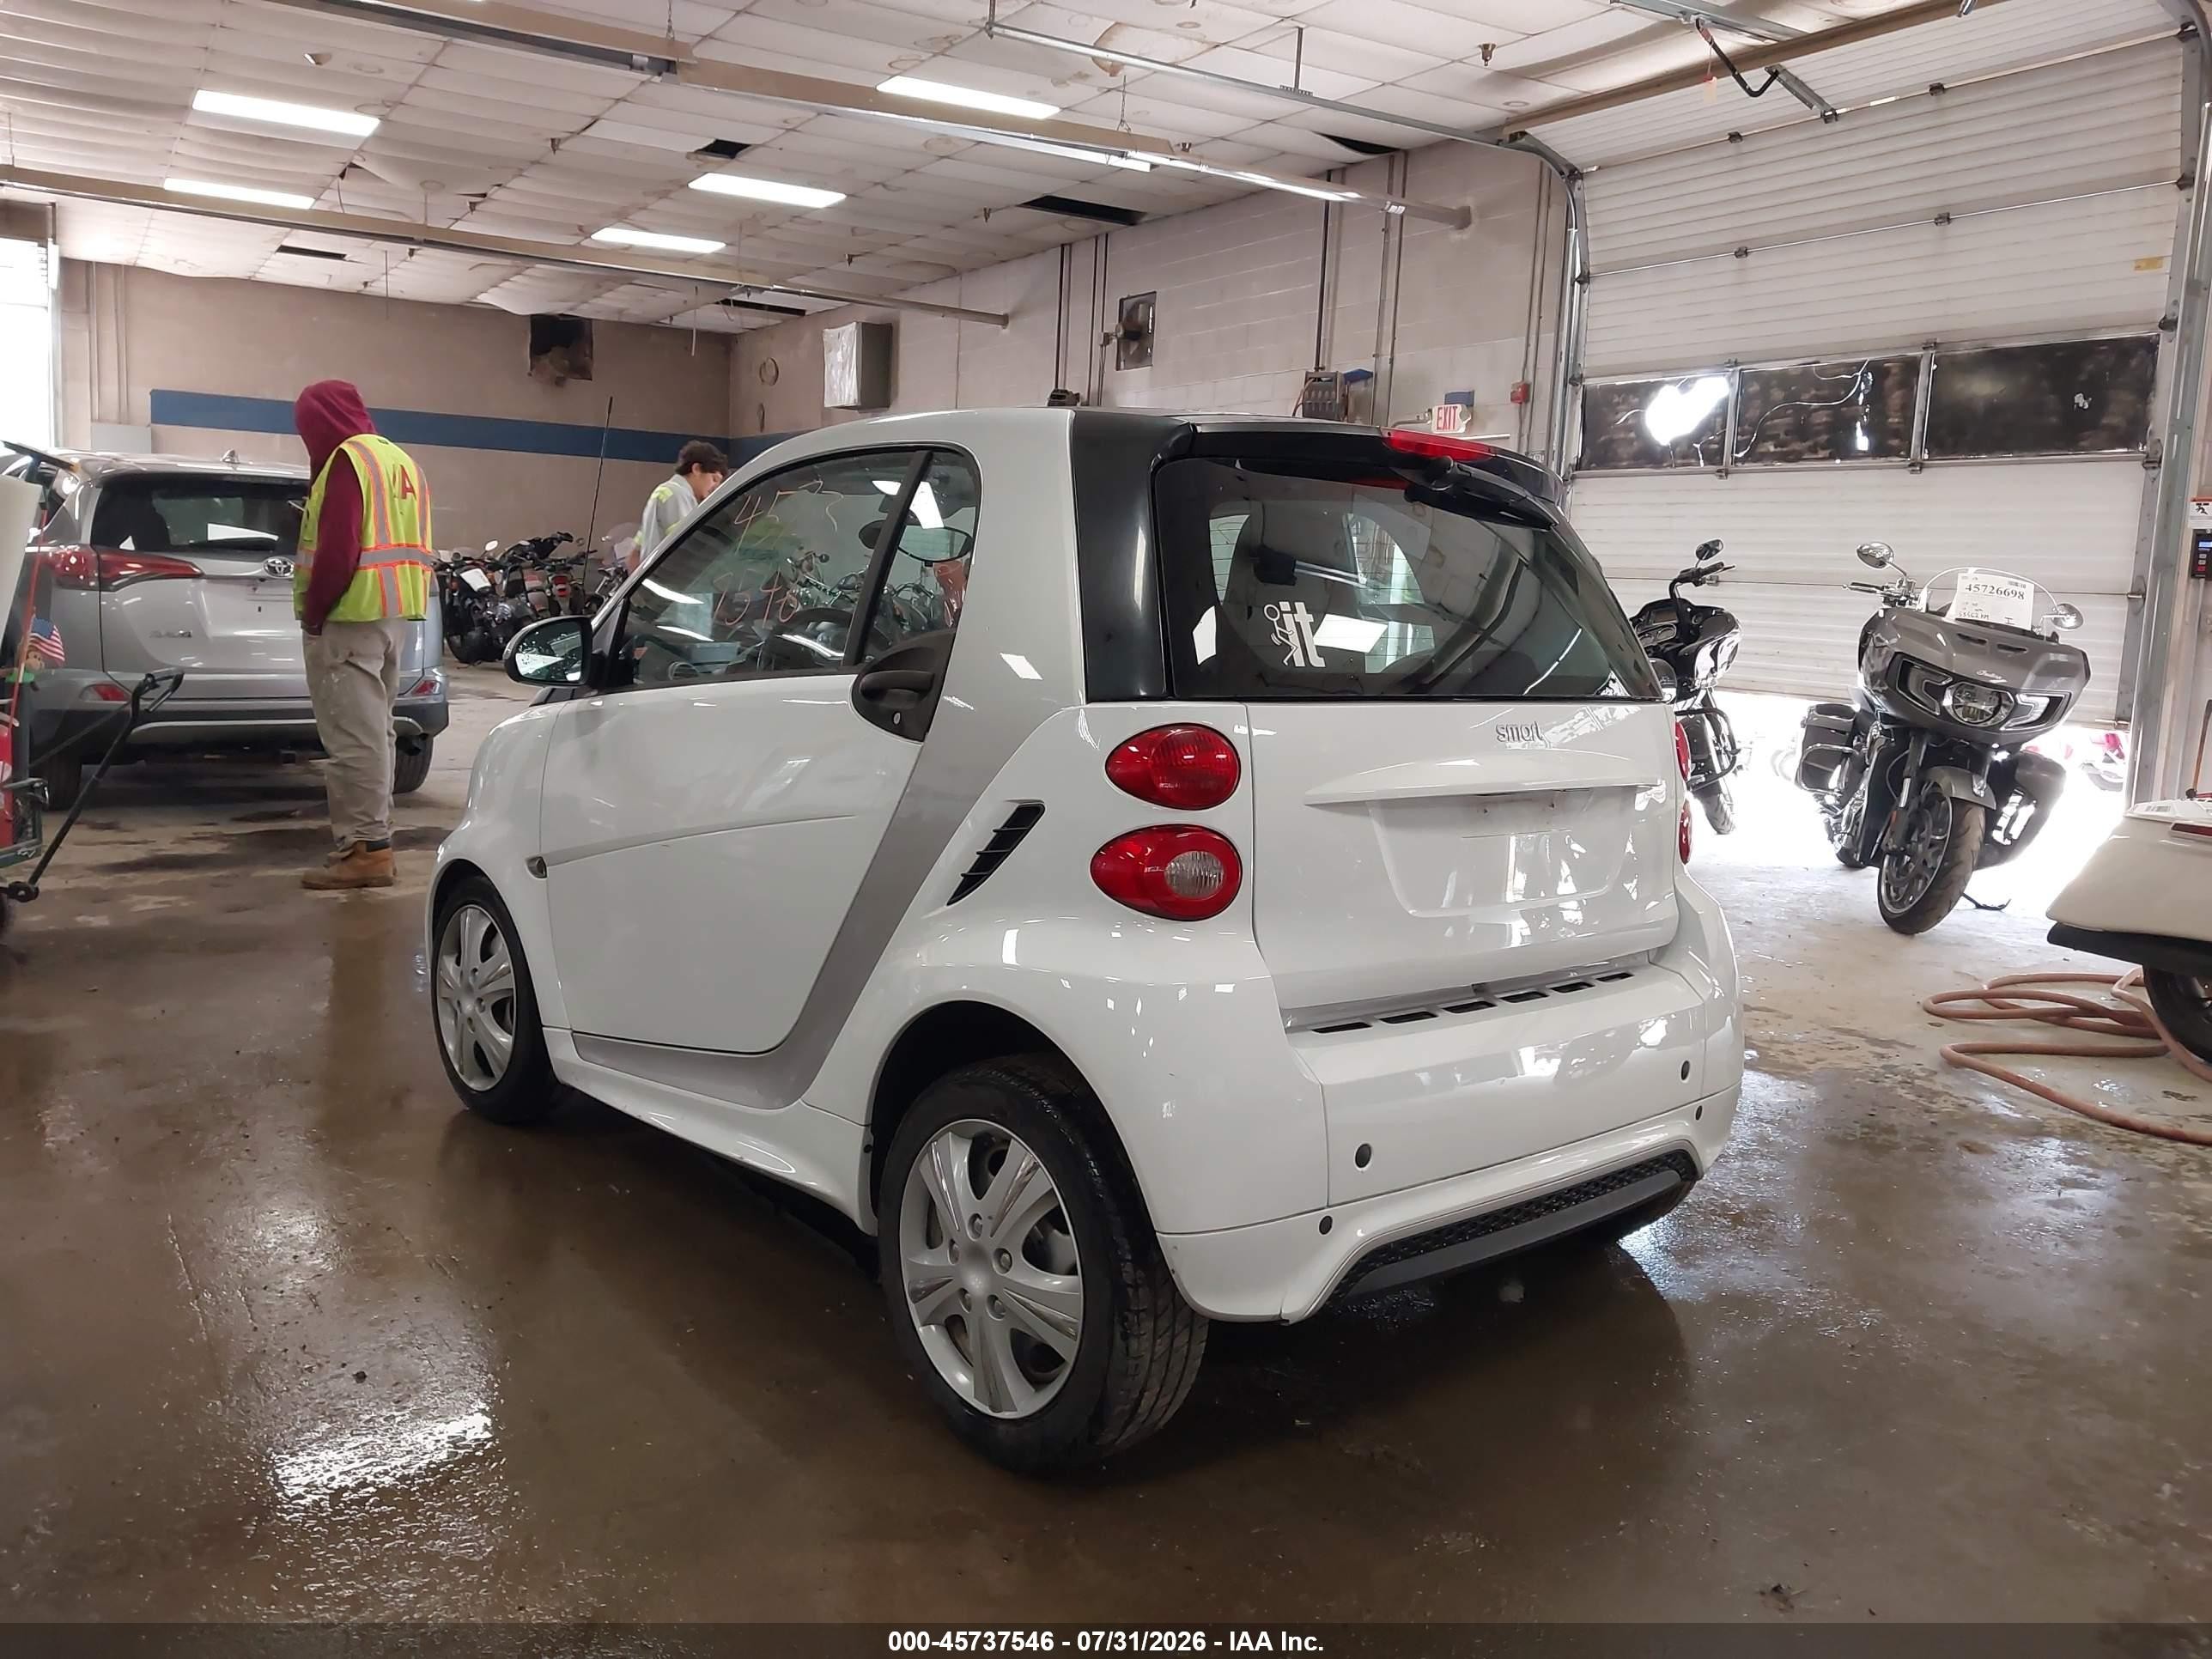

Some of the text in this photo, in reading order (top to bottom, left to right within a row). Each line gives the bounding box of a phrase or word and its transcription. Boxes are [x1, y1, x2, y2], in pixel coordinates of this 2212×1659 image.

[1437, 405, 1458, 430] EXIT
[1965, 583, 2025, 600] 45726698
[1279, 601, 1326, 666] it
[1496, 720, 1544, 742] smart
